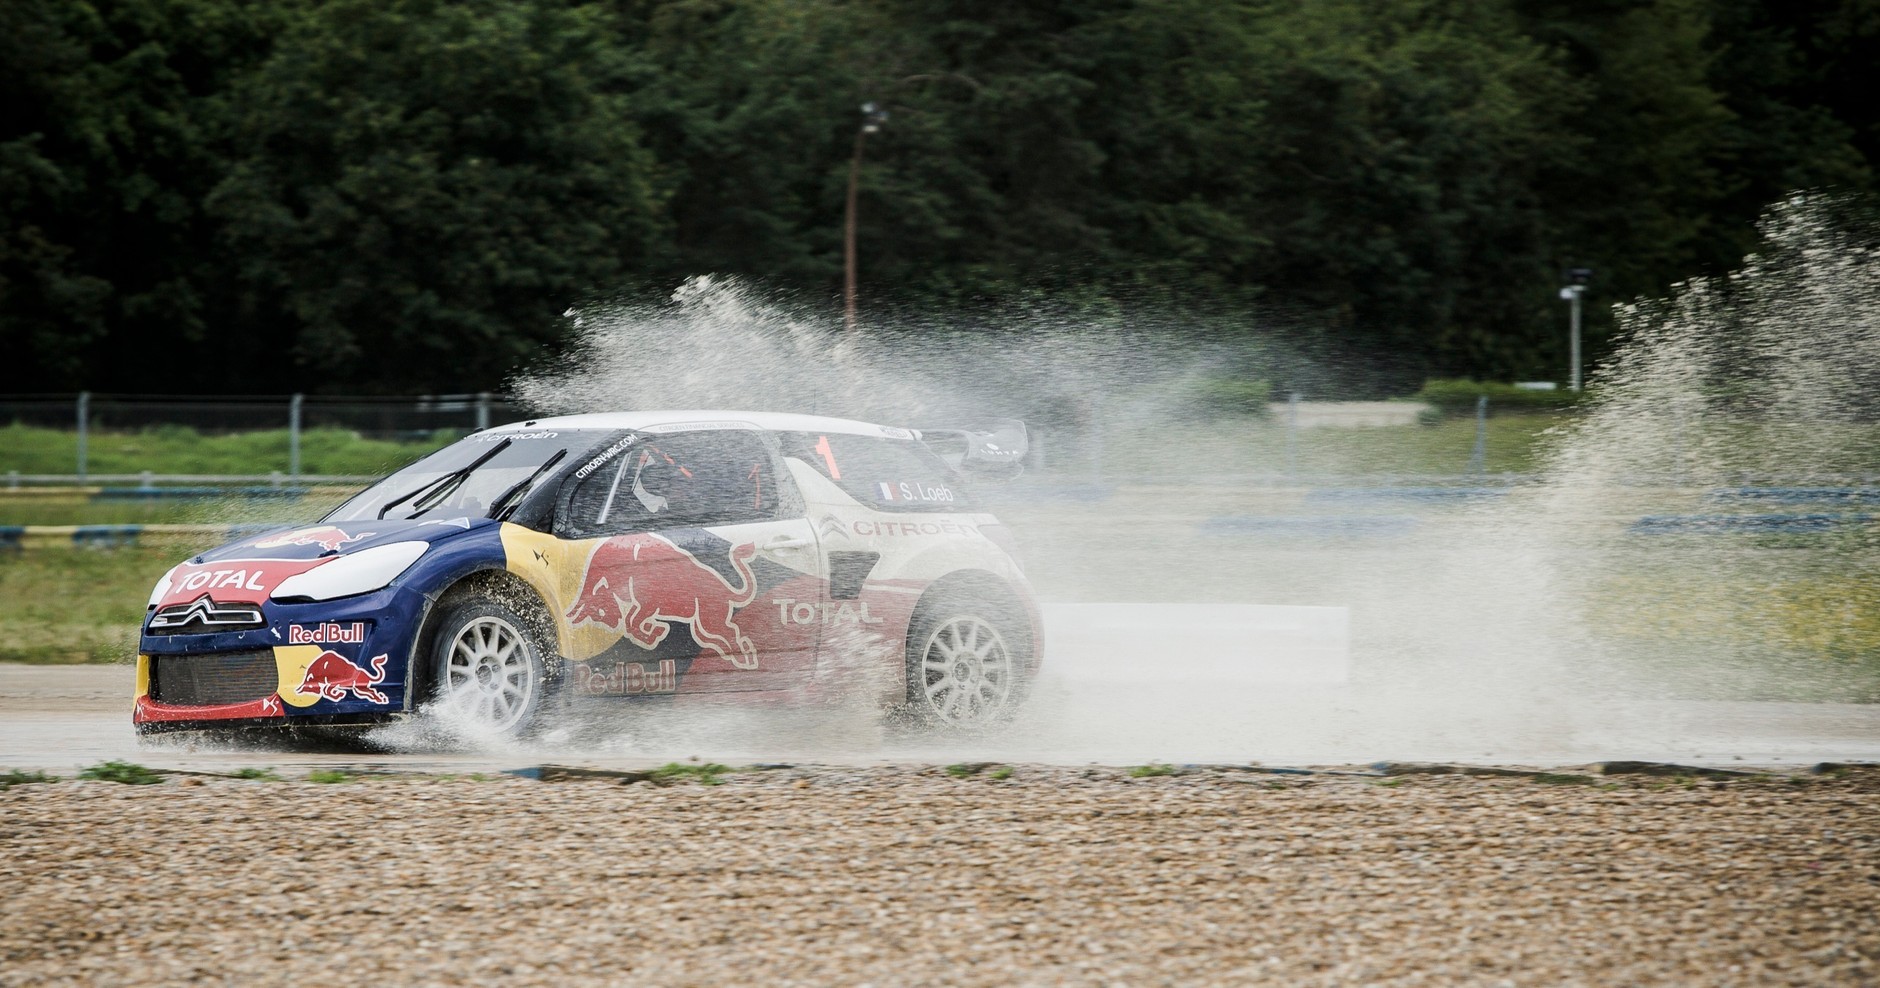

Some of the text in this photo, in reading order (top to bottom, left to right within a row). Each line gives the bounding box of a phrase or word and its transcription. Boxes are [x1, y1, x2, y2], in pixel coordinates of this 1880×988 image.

[814, 435, 841, 480] 1
[899, 482, 954, 502] S. Loeb
[175, 569, 265, 594] TOTAL
[772, 598, 884, 626] TOTAL
[289, 622, 364, 644] Red Bull
[574, 659, 676, 694] Red Bull
